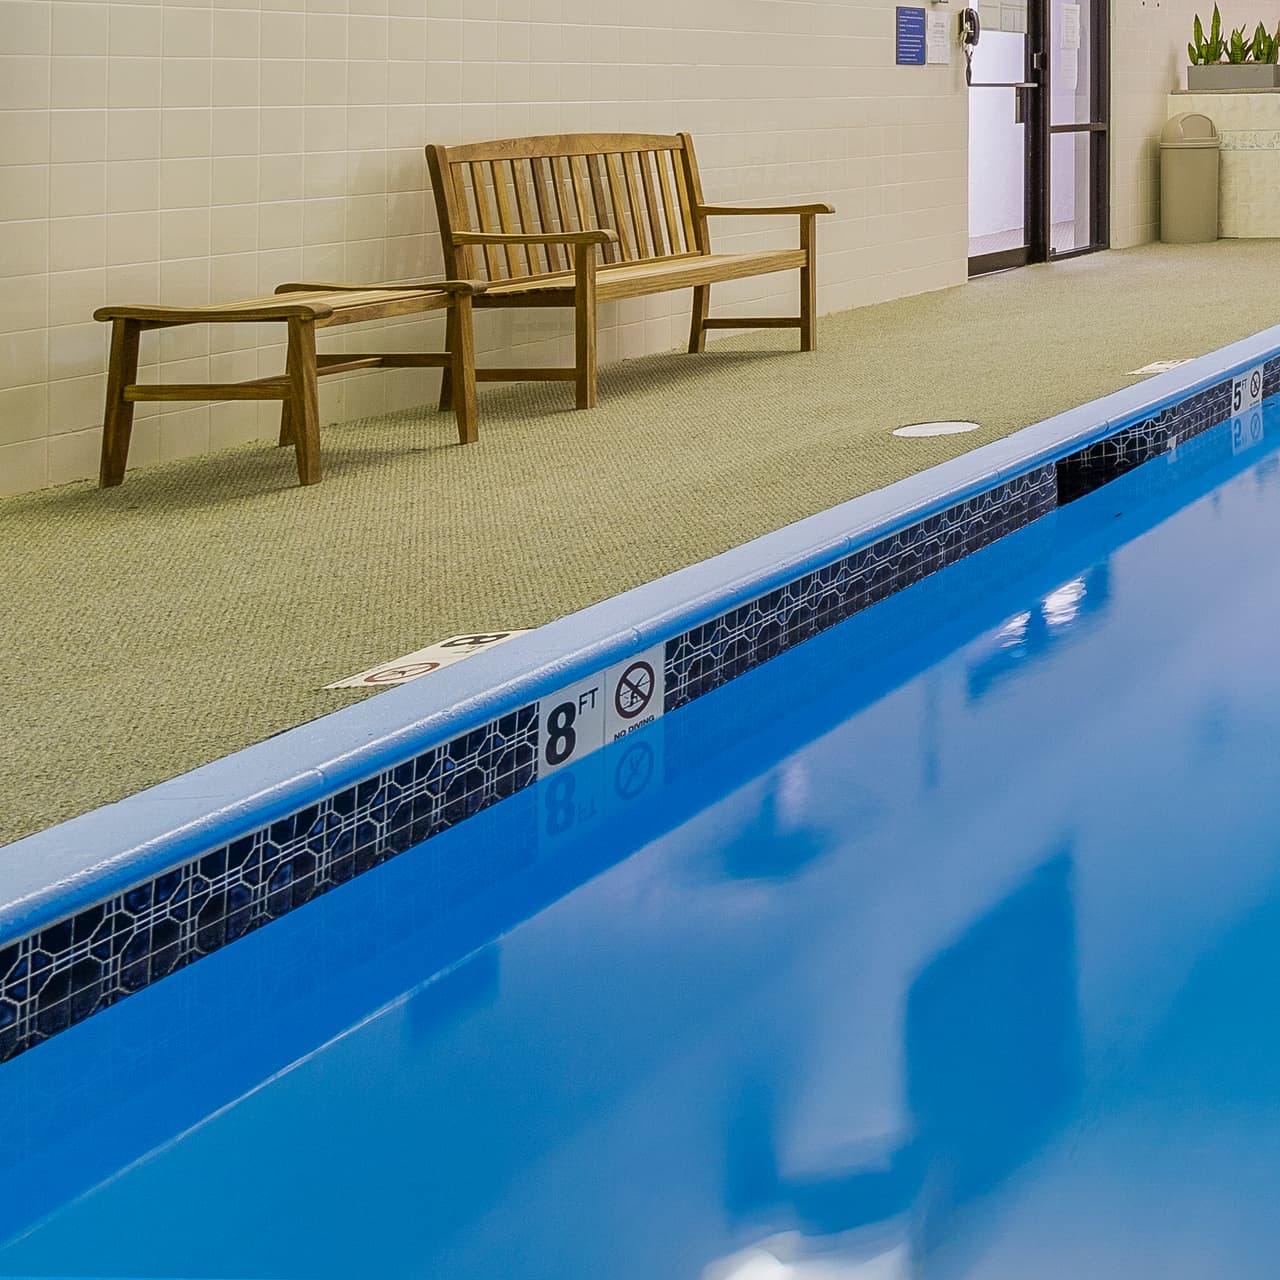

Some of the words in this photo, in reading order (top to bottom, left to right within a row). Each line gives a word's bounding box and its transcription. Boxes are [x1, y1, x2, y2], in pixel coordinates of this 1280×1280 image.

[1234, 381, 1241, 411] 5
[545, 702, 576, 766] 8
[579, 687, 598, 715] FT
[614, 730, 626, 740] NO
[628, 715, 655, 733] DIVING
